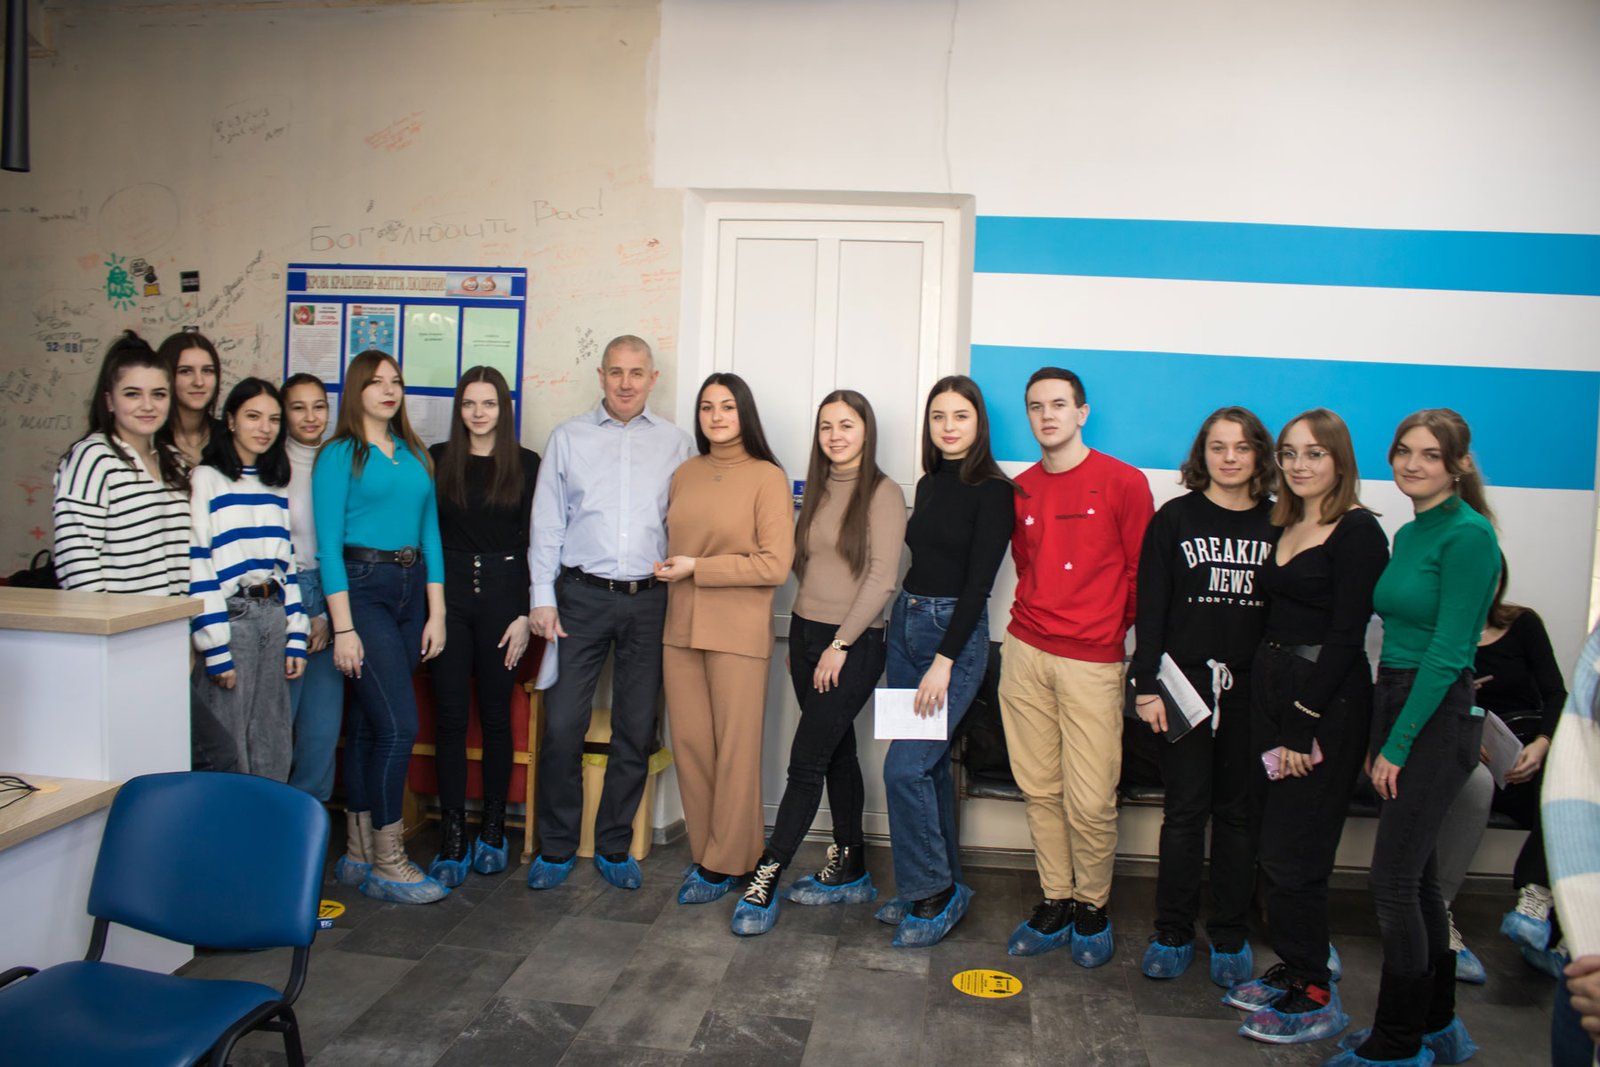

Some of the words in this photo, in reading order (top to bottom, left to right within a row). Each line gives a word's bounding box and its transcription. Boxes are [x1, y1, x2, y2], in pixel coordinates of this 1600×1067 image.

[310, 224, 376, 252] Бог
[1180, 536, 1272, 569] BREAKIN
[1208, 566, 1255, 595] NEWS
[1198, 596, 1234, 605] DON'T
